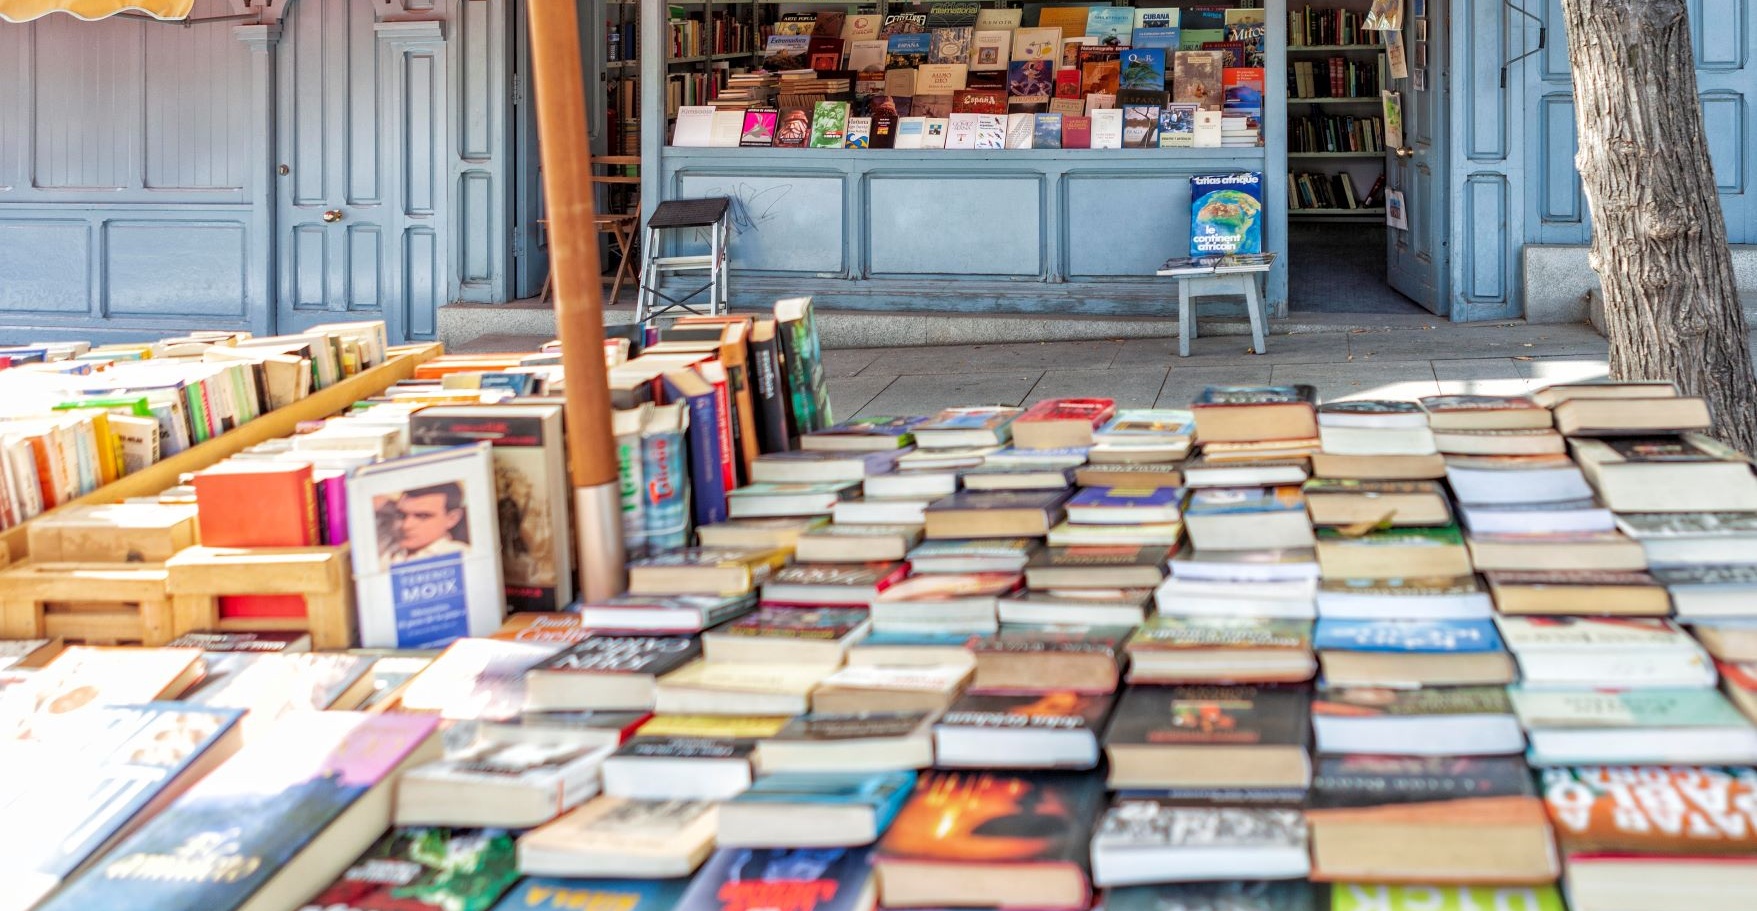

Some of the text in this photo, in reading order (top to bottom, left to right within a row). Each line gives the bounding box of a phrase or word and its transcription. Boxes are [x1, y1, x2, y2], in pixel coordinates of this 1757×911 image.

[1230, 26, 1265, 41] Mitos
[1222, 175, 1259, 185] afrique
[1205, 225, 1216, 234] le
[1193, 234, 1241, 242] continent
[1197, 242, 1236, 251] africain
[402, 578, 457, 603] MOIX
